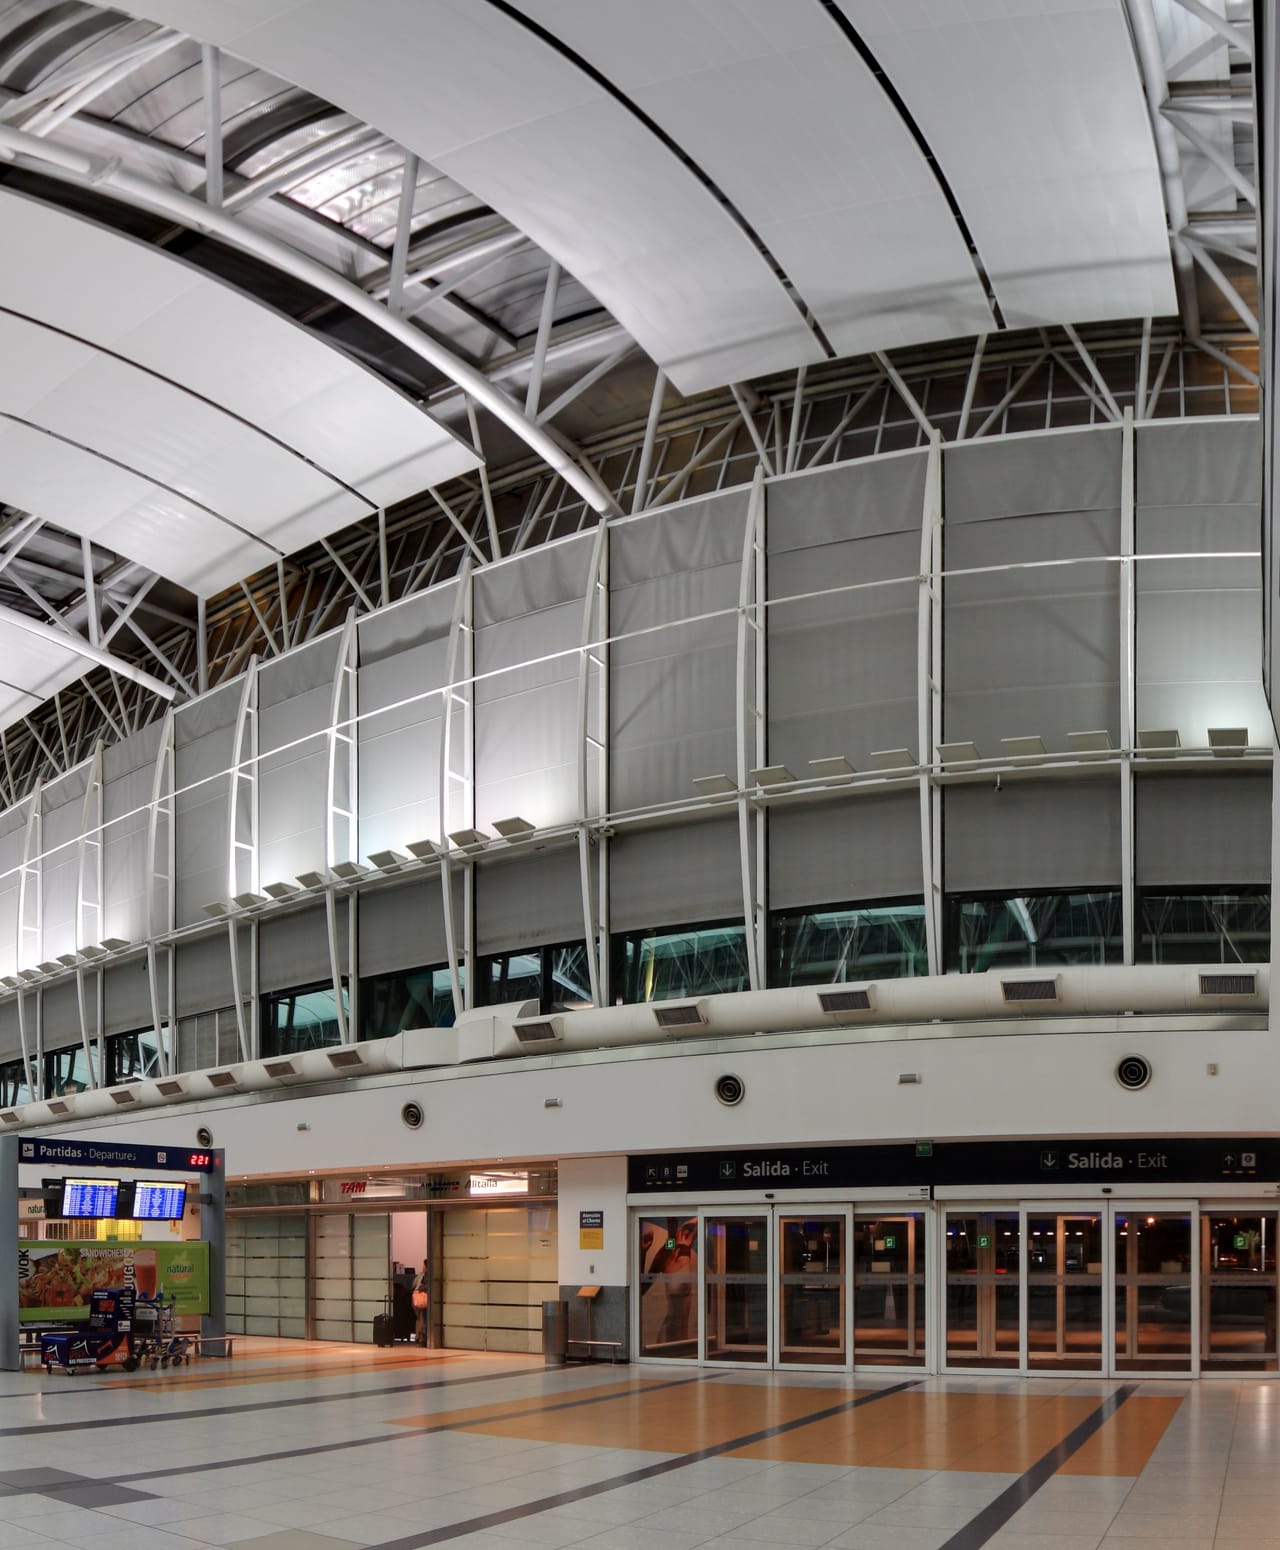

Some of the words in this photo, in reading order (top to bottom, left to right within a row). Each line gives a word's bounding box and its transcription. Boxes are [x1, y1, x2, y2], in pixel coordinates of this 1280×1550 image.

[40, 1145, 82, 1158] Partidas
[89, 1148, 136, 1161] Departures
[1068, 1152, 1123, 1169] Salida
[1138, 1152, 1168, 1168] Exit
[743, 1161, 790, 1176] Salida
[803, 1160, 829, 1176] Exit
[340, 1181, 367, 1194] TAM
[464, 1178, 498, 1189] Alitalia
[18, 1249, 29, 1279] WOK
[166, 1264, 194, 1273] natural
